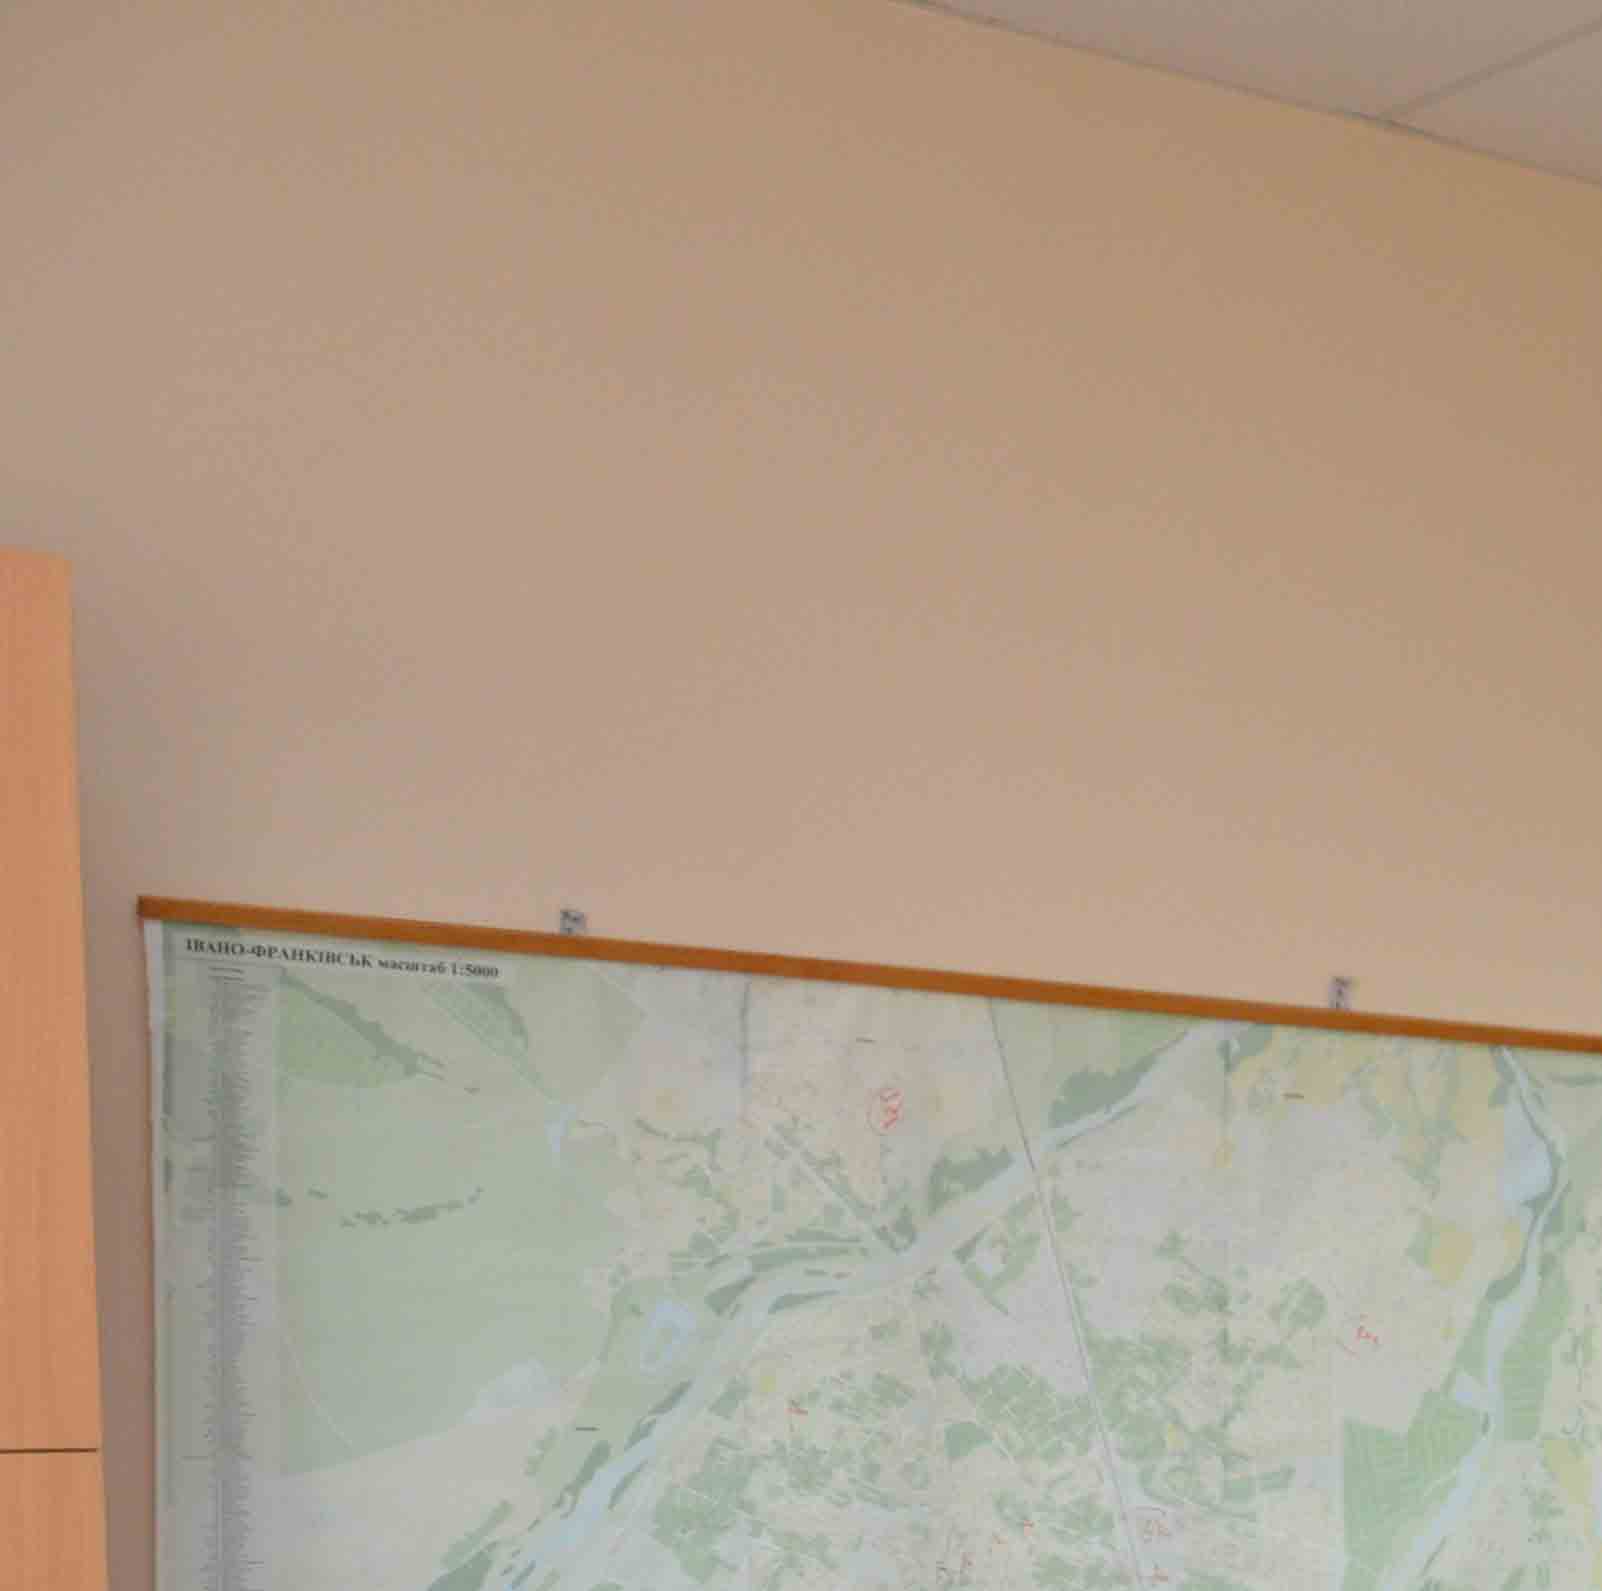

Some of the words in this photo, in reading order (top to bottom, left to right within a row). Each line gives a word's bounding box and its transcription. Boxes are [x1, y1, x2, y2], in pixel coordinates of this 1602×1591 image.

[185, 937, 374, 969] ІВАНО-ФРАНКІВСЬК
[377, 959, 447, 974] масштаб
[451, 961, 500, 977] 1:5000
